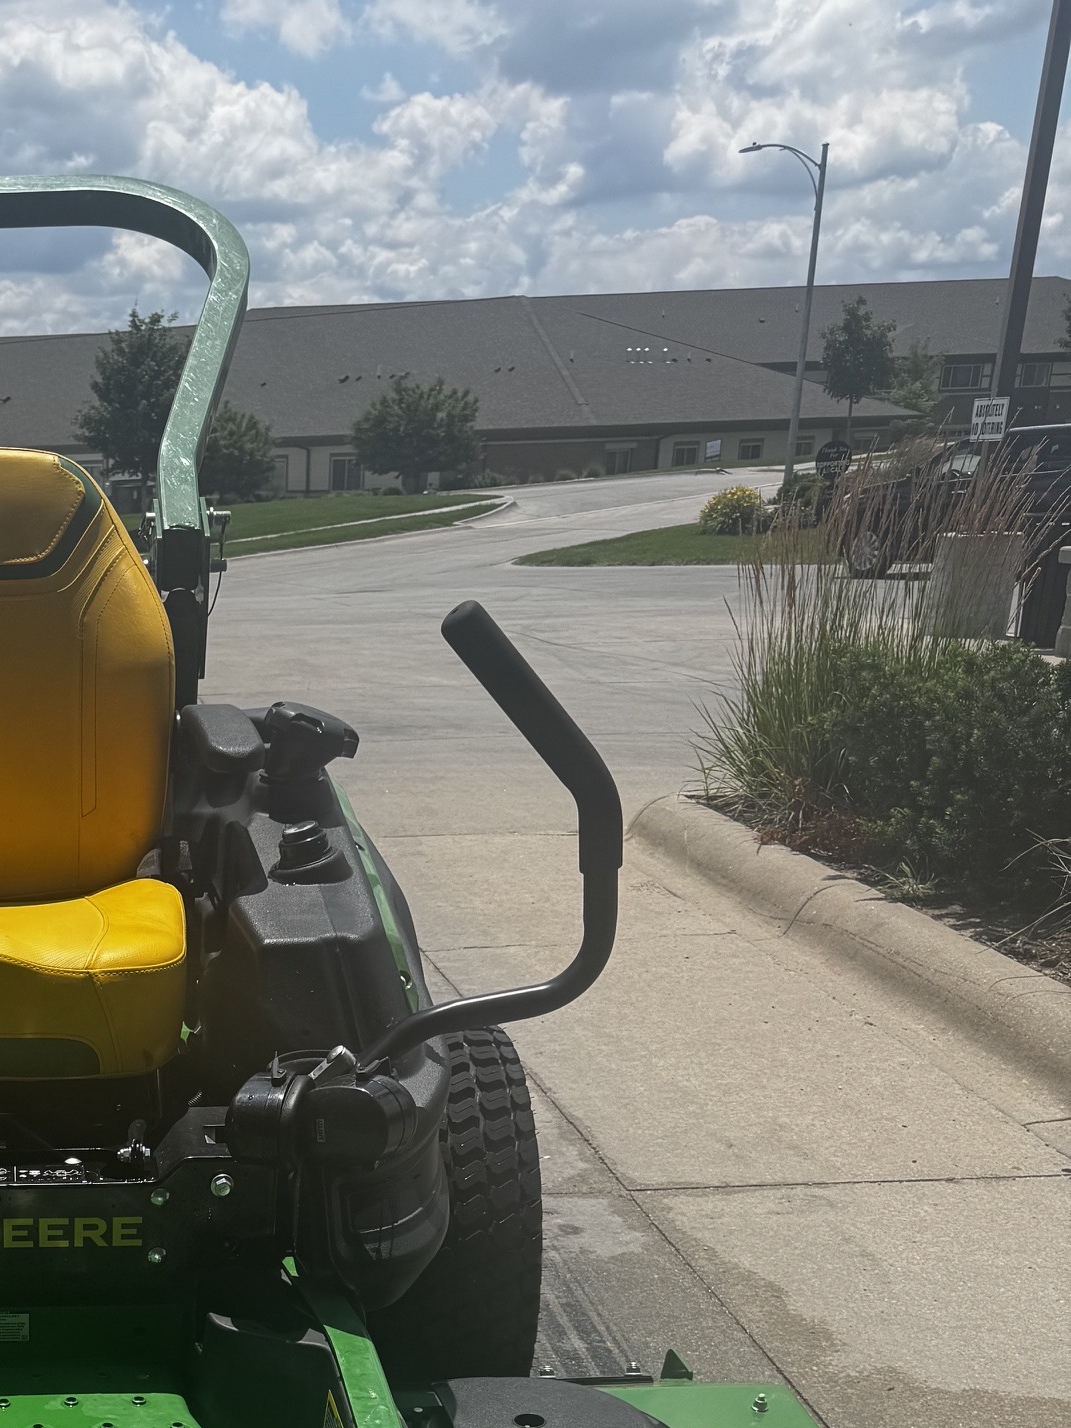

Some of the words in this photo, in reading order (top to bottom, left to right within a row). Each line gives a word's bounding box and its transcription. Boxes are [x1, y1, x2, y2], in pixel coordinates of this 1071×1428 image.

[976, 404, 1004, 418] ABSOLUTELY
[972, 422, 978, 436] NO
[980, 422, 1004, 435] LOITERING
